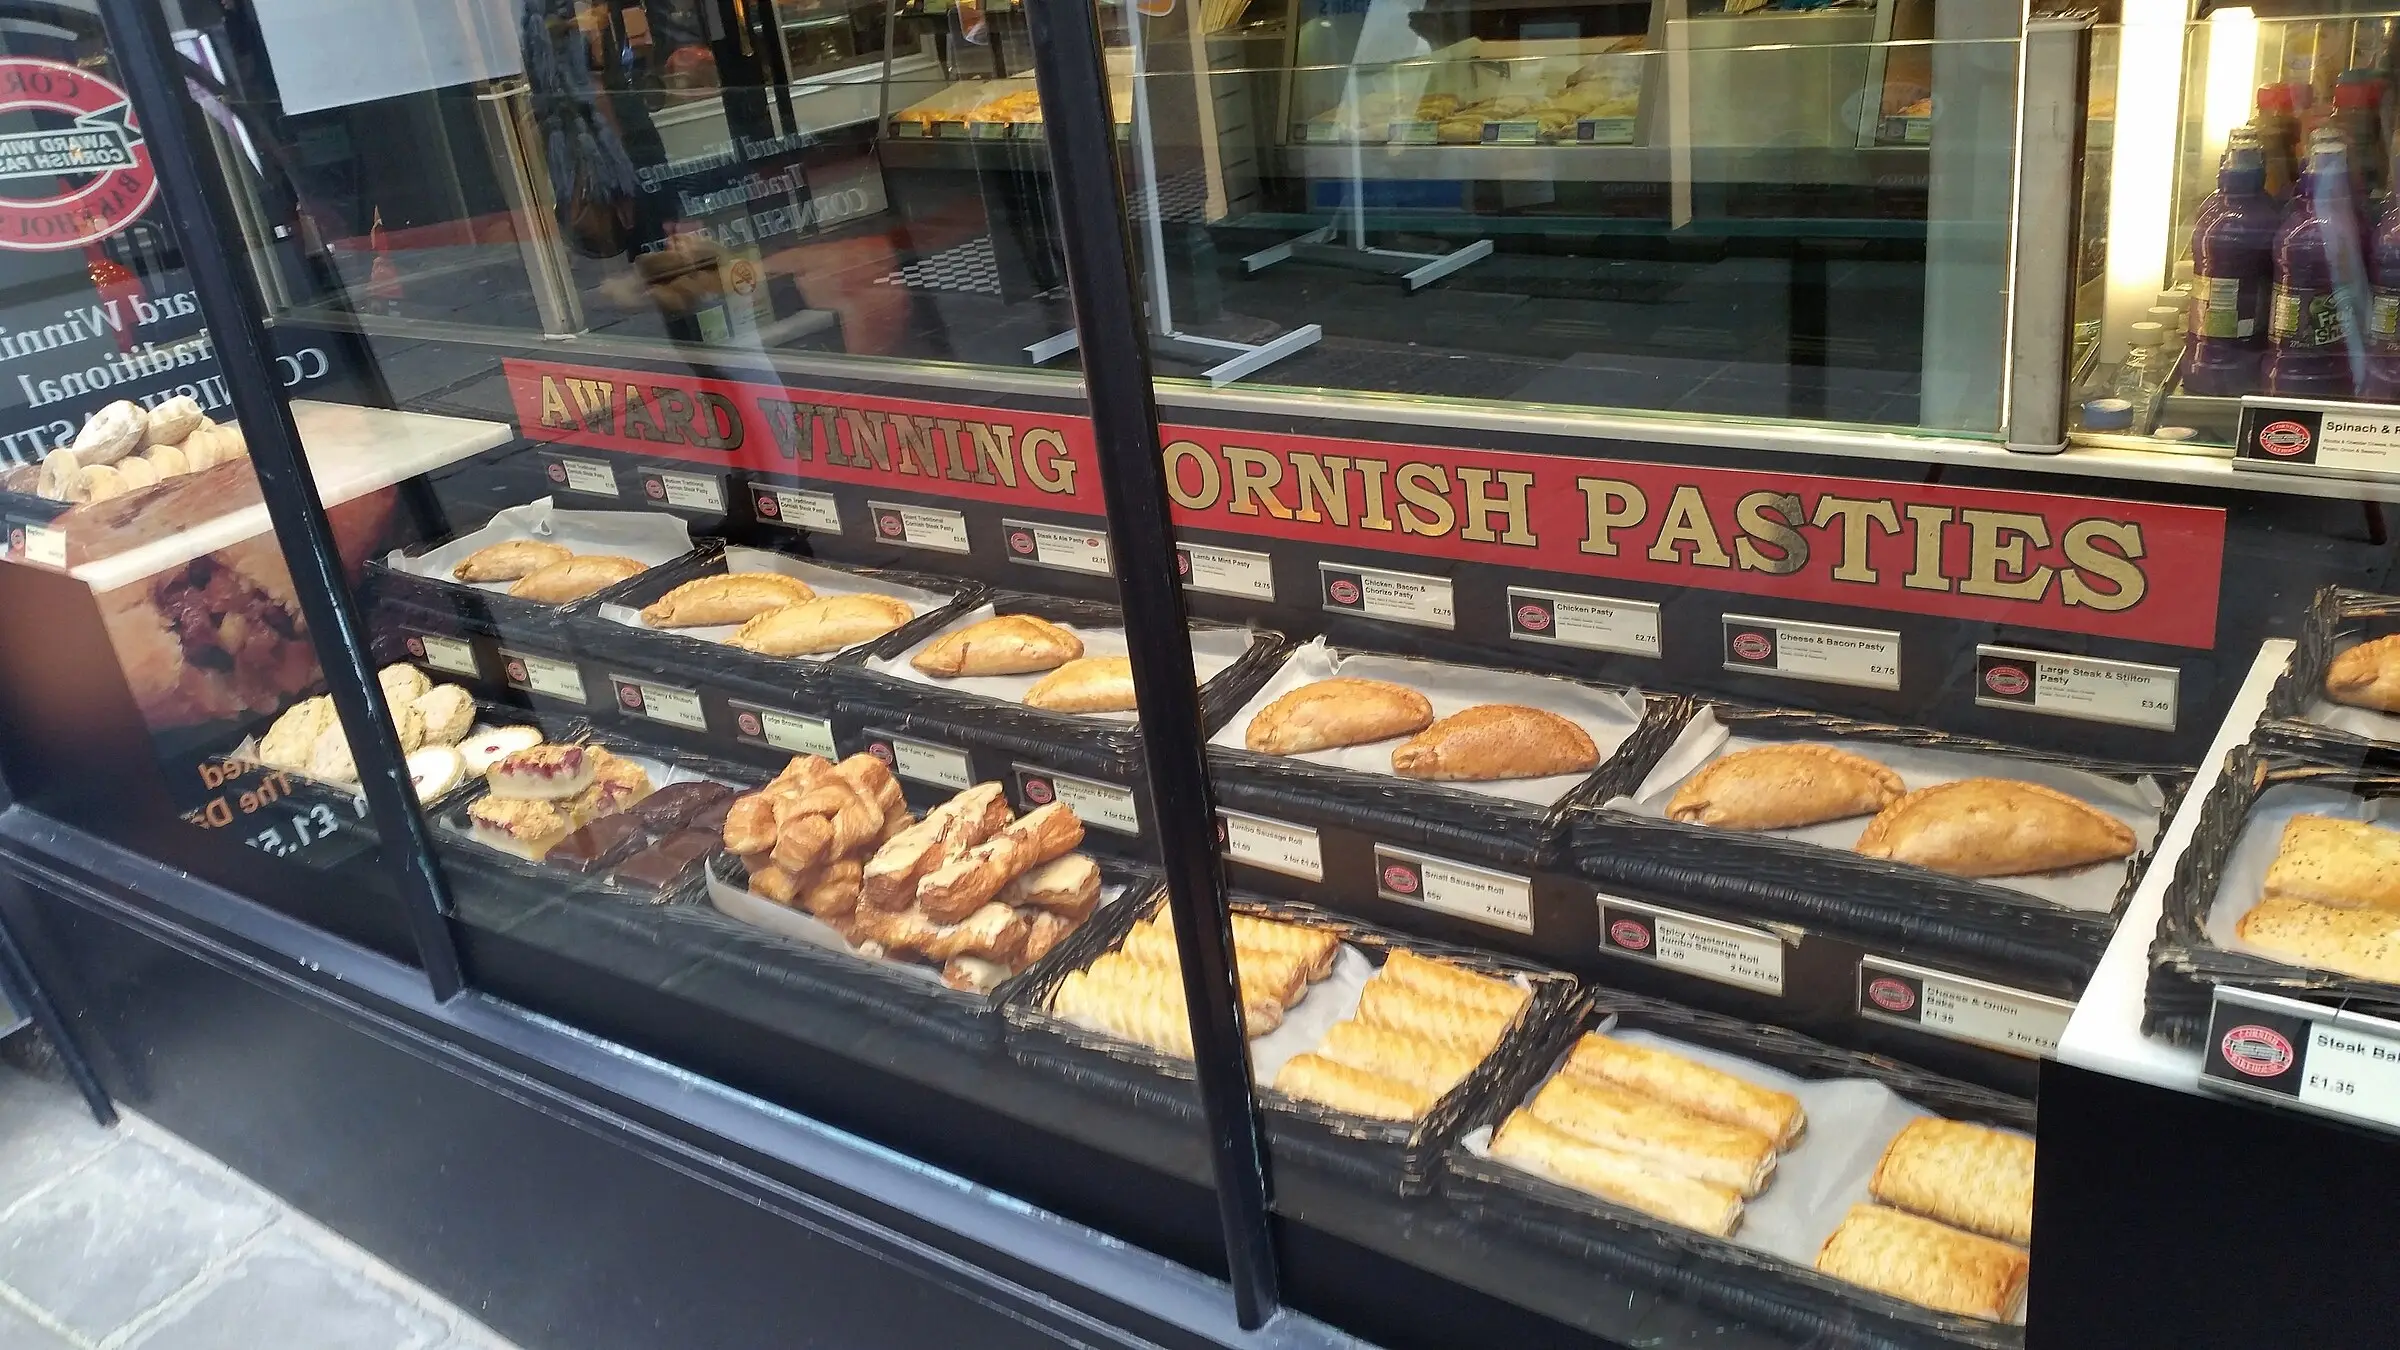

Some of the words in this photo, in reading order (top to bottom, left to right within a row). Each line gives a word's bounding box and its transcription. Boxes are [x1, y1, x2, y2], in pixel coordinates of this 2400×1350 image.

[2327, 421, 2377, 433] Spinach
[2381, 425, 2390, 434] &
[541, 375, 743, 450] AWARD
[756, 398, 1078, 496] WINNING
[1163, 440, 1539, 549] ORNISH
[1577, 475, 2149, 611] PASTIES
[1232, 560, 1250, 569] Pasty
[1364, 579, 1395, 590] Chicken,
[1396, 582, 1419, 592] Bacon
[1366, 586, 1392, 596] Chorizo
[1394, 590, 1414, 600] Pasty
[1433, 608, 1452, 616] £2.75
[1556, 603, 1589, 614] Chicken
[1590, 607, 1614, 618] Pasty
[1635, 634, 1656, 642] £2.75
[1780, 632, 1814, 644] Cheese
[1826, 638, 1856, 648] Bacon
[1858, 642, 1885, 652] Pasty
[1870, 665, 1895, 675] £2.75
[2040, 664, 2070, 676] Large
[2072, 668, 2102, 678] Steak
[2104, 671, 2112, 679] &
[2116, 672, 2150, 684] Stilton
[2040, 674, 2069, 686] Pasty
[2141, 700, 2168, 710] £3.40
[1230, 822, 1254, 834] Jumbo
[1256, 828, 1287, 842] Sausage
[1290, 855, 1300, 864] for
[1424, 870, 1448, 882] Small
[1450, 876, 1486, 890] Sausage
[1488, 885, 1504, 896] Roll
[1493, 906, 1504, 916] for
[1660, 926, 1686, 940] Spicy
[1688, 932, 1740, 950] Vegetarian
[1660, 936, 1692, 949] Jumbo
[1695, 943, 1736, 960] Sausage
[1740, 953, 1760, 964] Roll
[1730, 964, 1736, 972] 2
[1739, 966, 1752, 975] for
[1926, 996, 1954, 1010] Bake
[1927, 987, 1968, 1004] Cheese
[1972, 998, 1979, 1006] &
[1984, 1000, 2018, 1016] Onion
[2008, 1030, 2014, 1039] 2
[2016, 1032, 2032, 1044] for
[2317, 1034, 2366, 1056] Steak
[2309, 1074, 2355, 1096] £1.35
